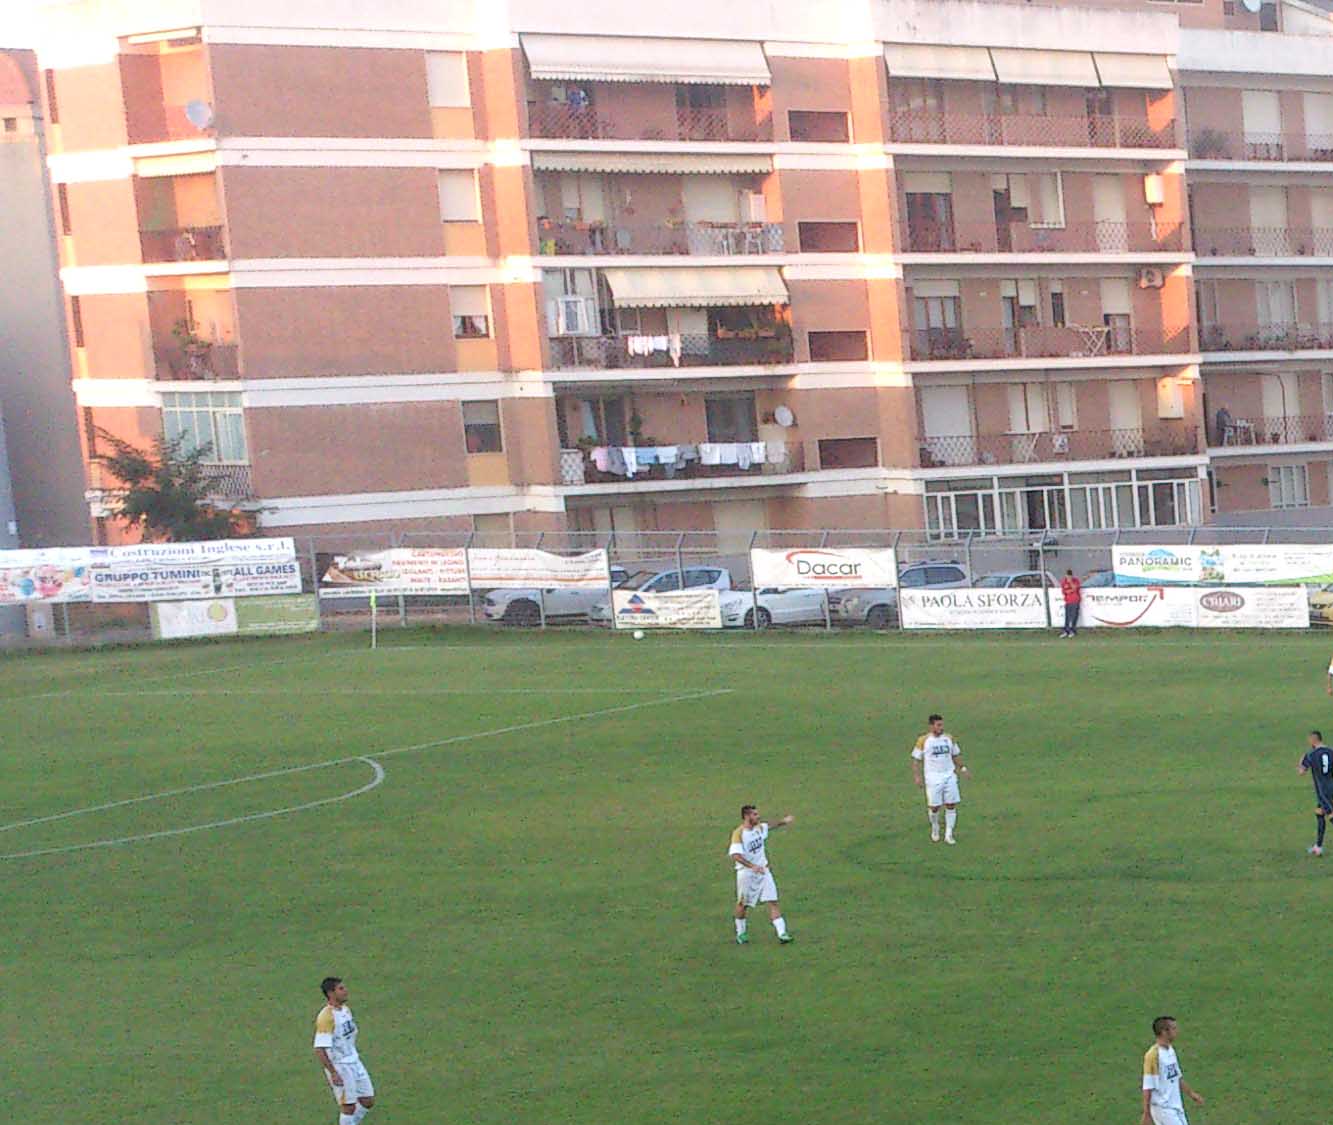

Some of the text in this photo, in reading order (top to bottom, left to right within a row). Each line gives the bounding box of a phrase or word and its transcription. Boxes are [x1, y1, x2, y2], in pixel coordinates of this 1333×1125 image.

[233, 564, 296, 576] ALL GAMES
[797, 558, 862, 575] Dacar
[95, 569, 200, 583] GRUPPO TUMINI
[922, 593, 1042, 608] PAOLA SFORZA
